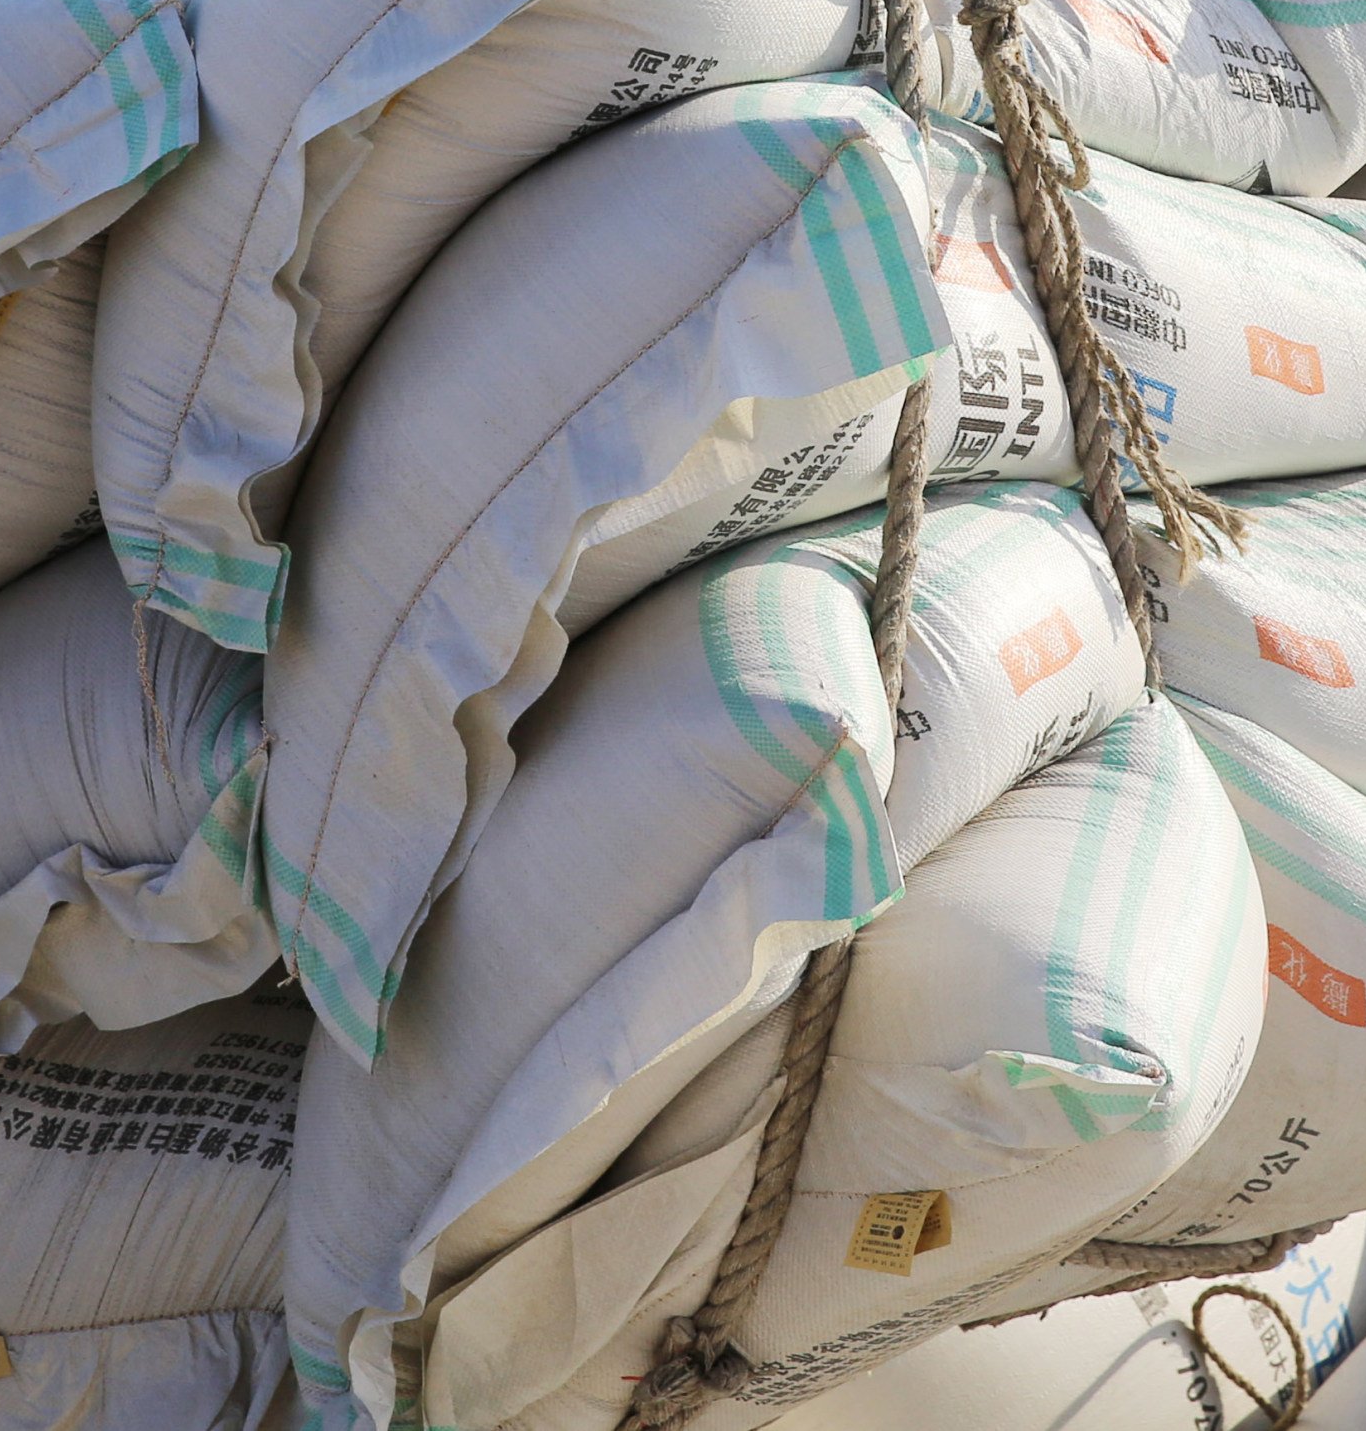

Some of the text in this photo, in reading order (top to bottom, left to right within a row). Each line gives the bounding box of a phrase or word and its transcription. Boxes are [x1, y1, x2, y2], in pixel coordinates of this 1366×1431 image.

[648, 53, 697, 102] 214号
[1251, 44, 1306, 75] OFCO
[1257, 336, 1314, 388] 膨化
[1002, 334, 1045, 460] INTL
[1280, 941, 1352, 1018] 膨化
[1281, 1248, 1356, 1385] 大豆
